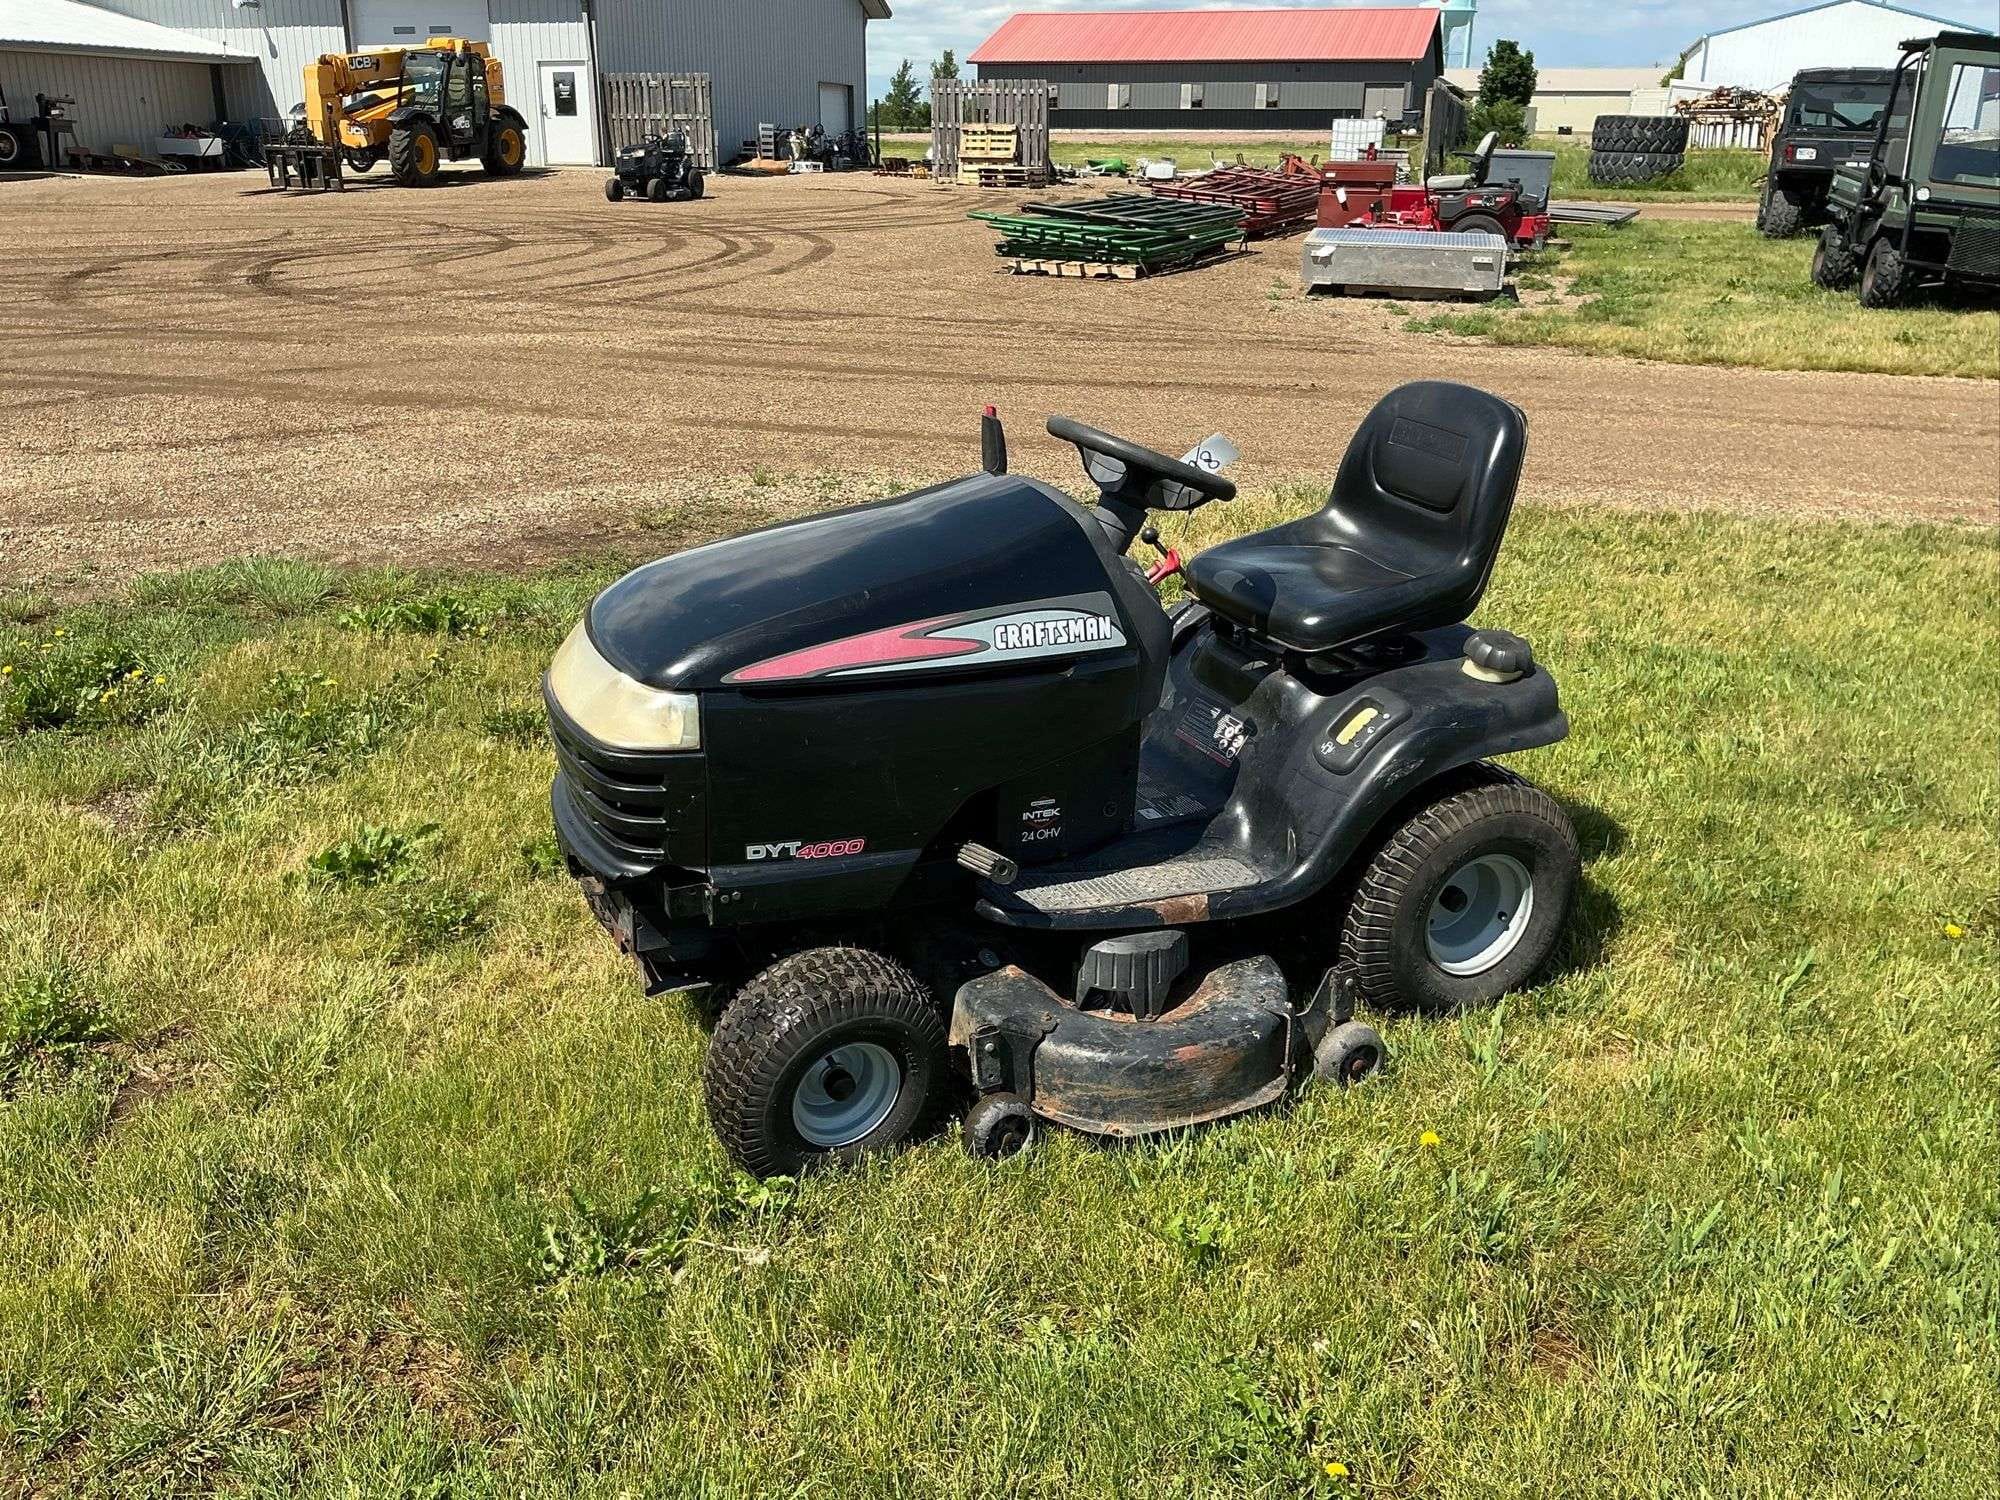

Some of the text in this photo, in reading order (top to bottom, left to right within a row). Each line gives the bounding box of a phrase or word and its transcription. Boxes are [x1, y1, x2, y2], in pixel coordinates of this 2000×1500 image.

[350, 57, 371, 69] JCB
[994, 615, 1112, 650] CRAFTSMAN
[1022, 807, 1061, 821] INTEK
[1021, 826, 1062, 842] 24 OHV
